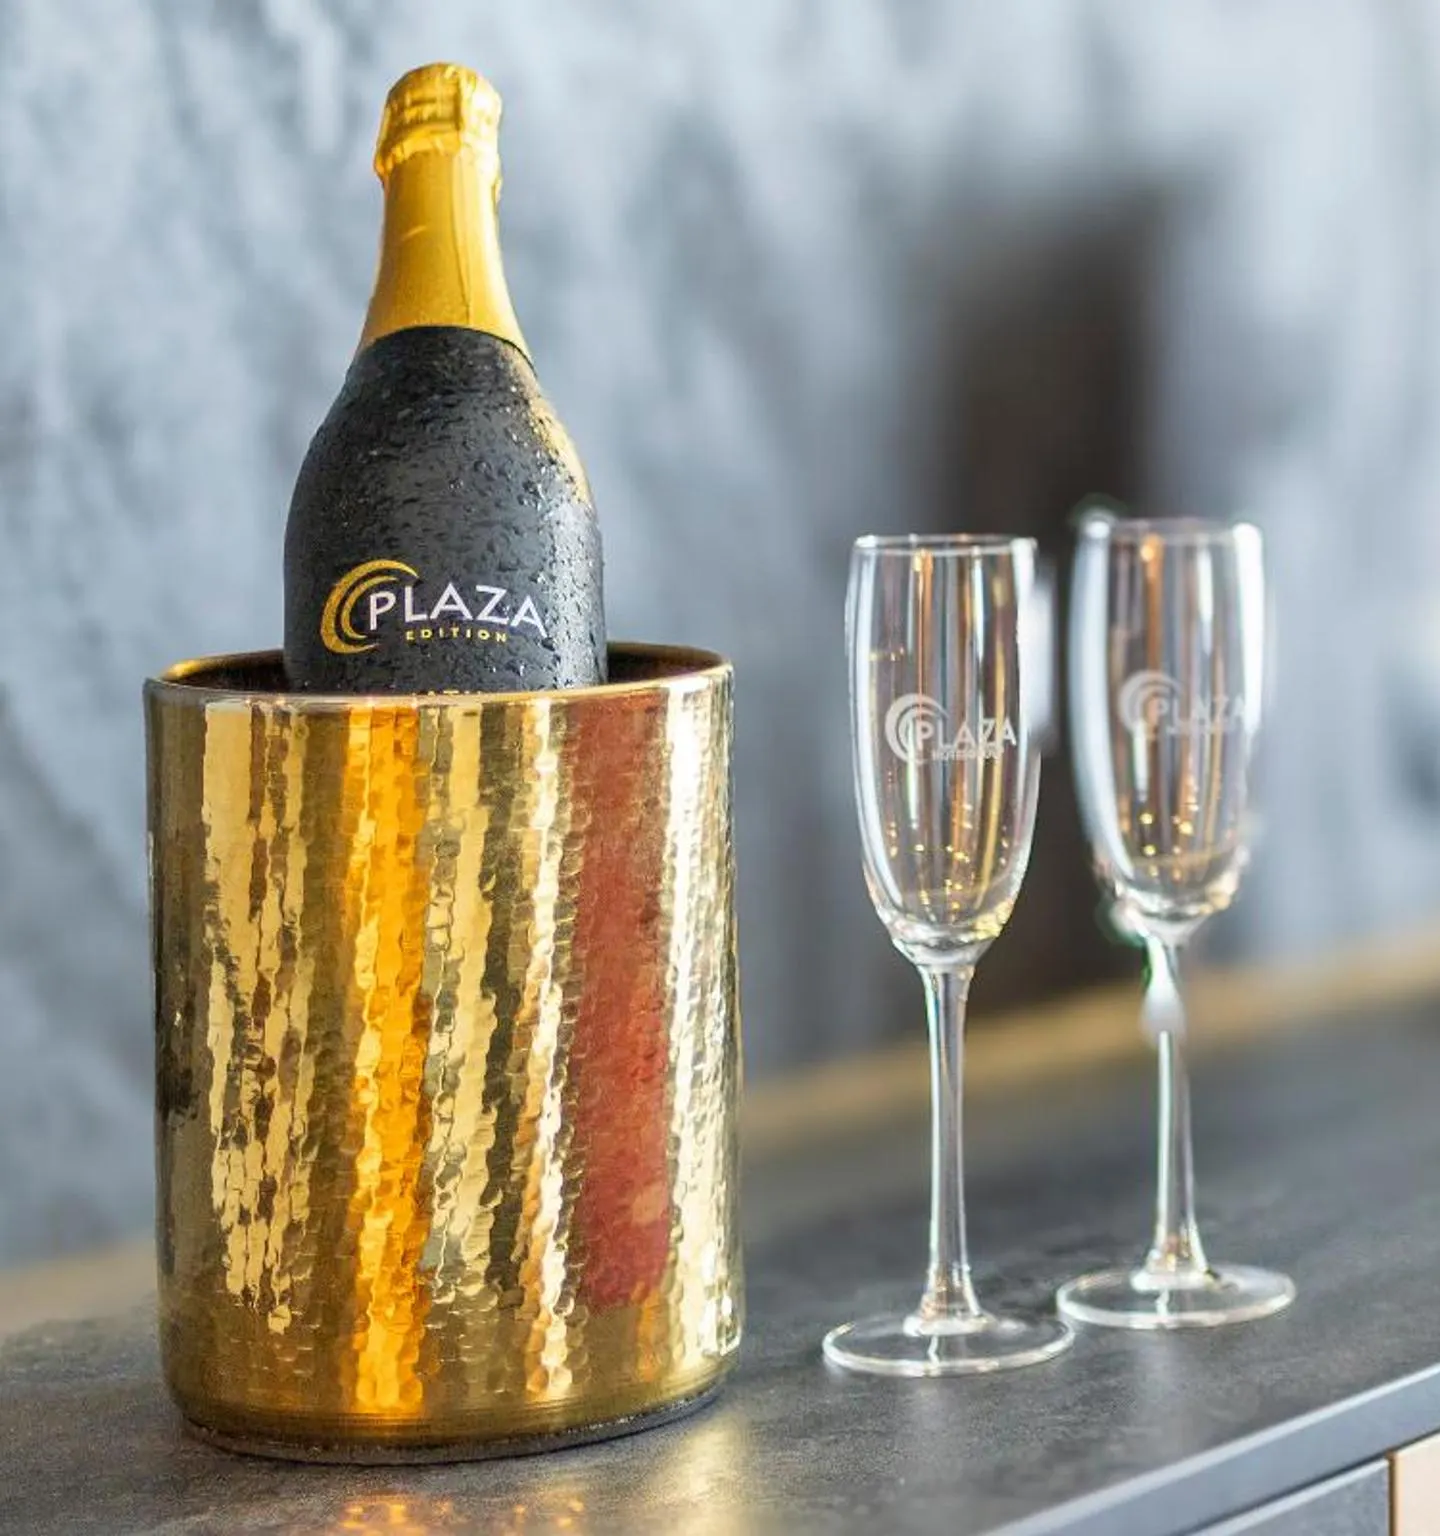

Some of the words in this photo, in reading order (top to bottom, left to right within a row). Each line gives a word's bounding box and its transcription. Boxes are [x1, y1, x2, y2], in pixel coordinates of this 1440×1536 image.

[369, 582, 549, 639] PLAZA
[405, 626, 507, 644] EDITION
[916, 716, 1017, 751] PLAZA
